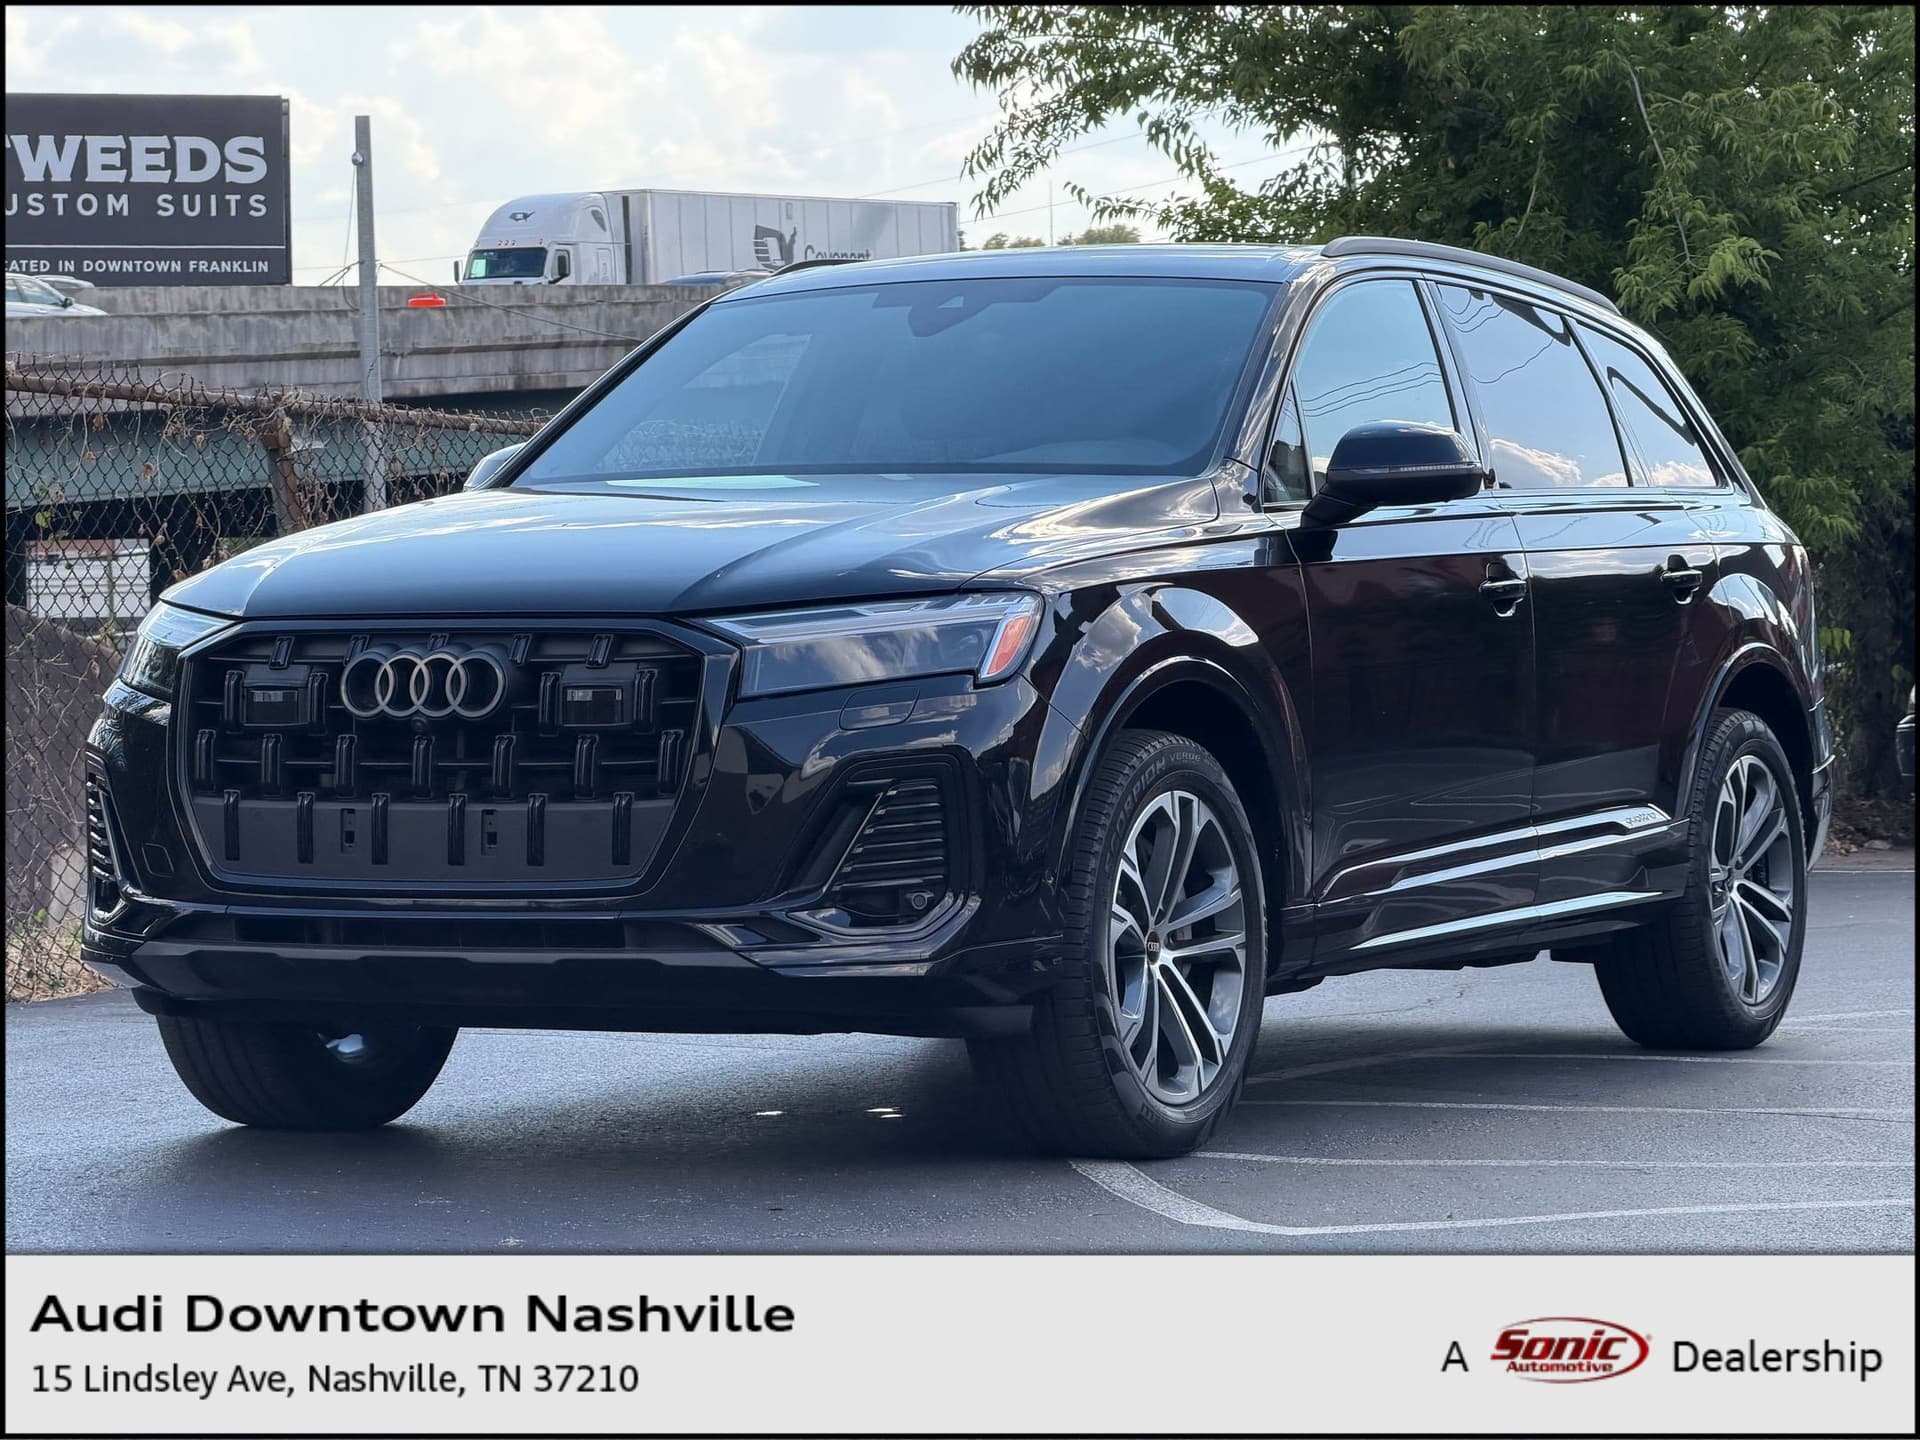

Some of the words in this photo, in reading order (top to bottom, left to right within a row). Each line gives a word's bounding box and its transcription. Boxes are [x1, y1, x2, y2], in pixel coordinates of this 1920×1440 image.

[5, 134, 268, 184] WEEDS
[156, 193, 267, 217] SUITS
[58, 259, 75, 273] IN
[82, 259, 182, 273] DOWNTOWN
[188, 260, 269, 273] FRANKLIN
